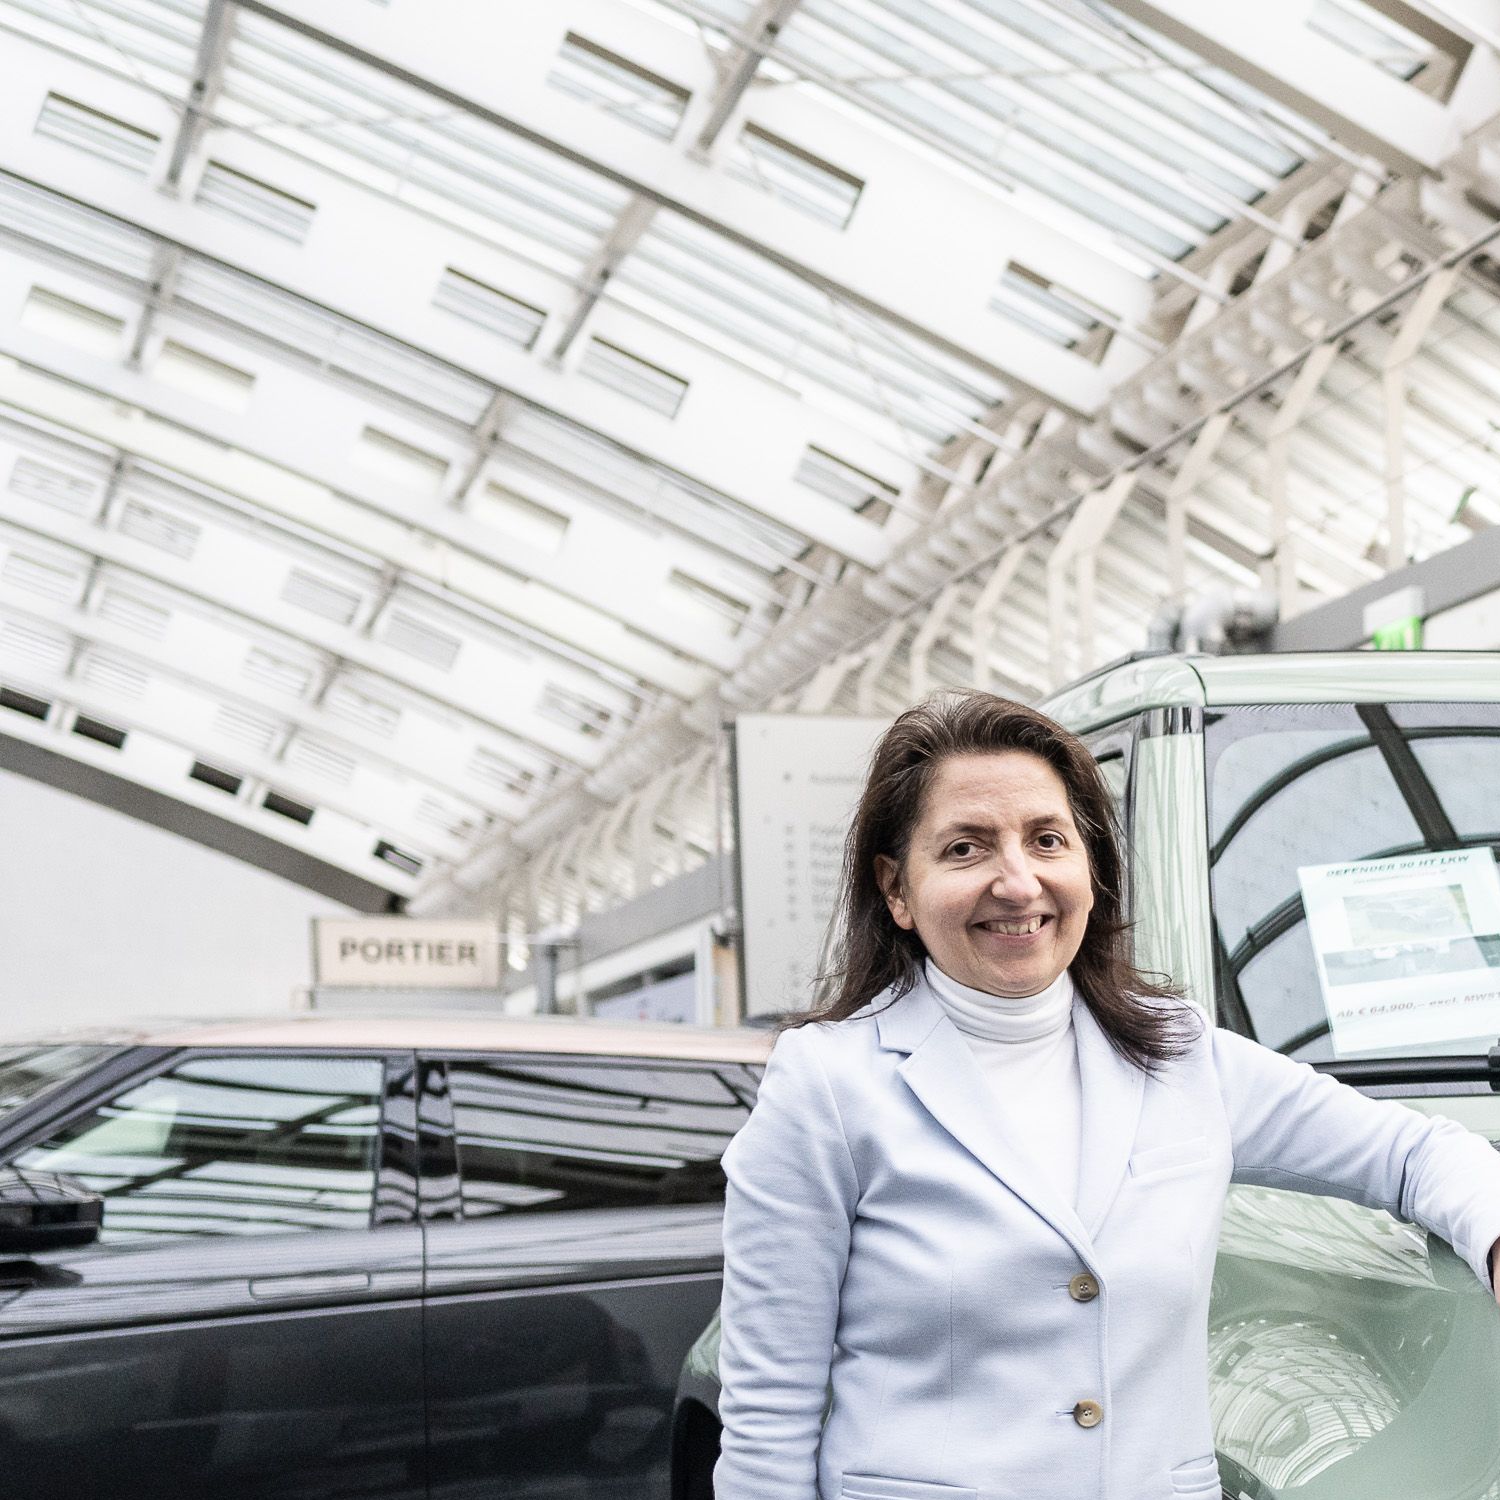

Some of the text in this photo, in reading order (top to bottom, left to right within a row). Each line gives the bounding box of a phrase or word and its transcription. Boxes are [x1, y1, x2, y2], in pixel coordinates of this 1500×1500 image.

[1326, 862, 1395, 877] DEFENDER
[1440, 855, 1470, 865] LKW
[339, 936, 477, 966] PORTIER
